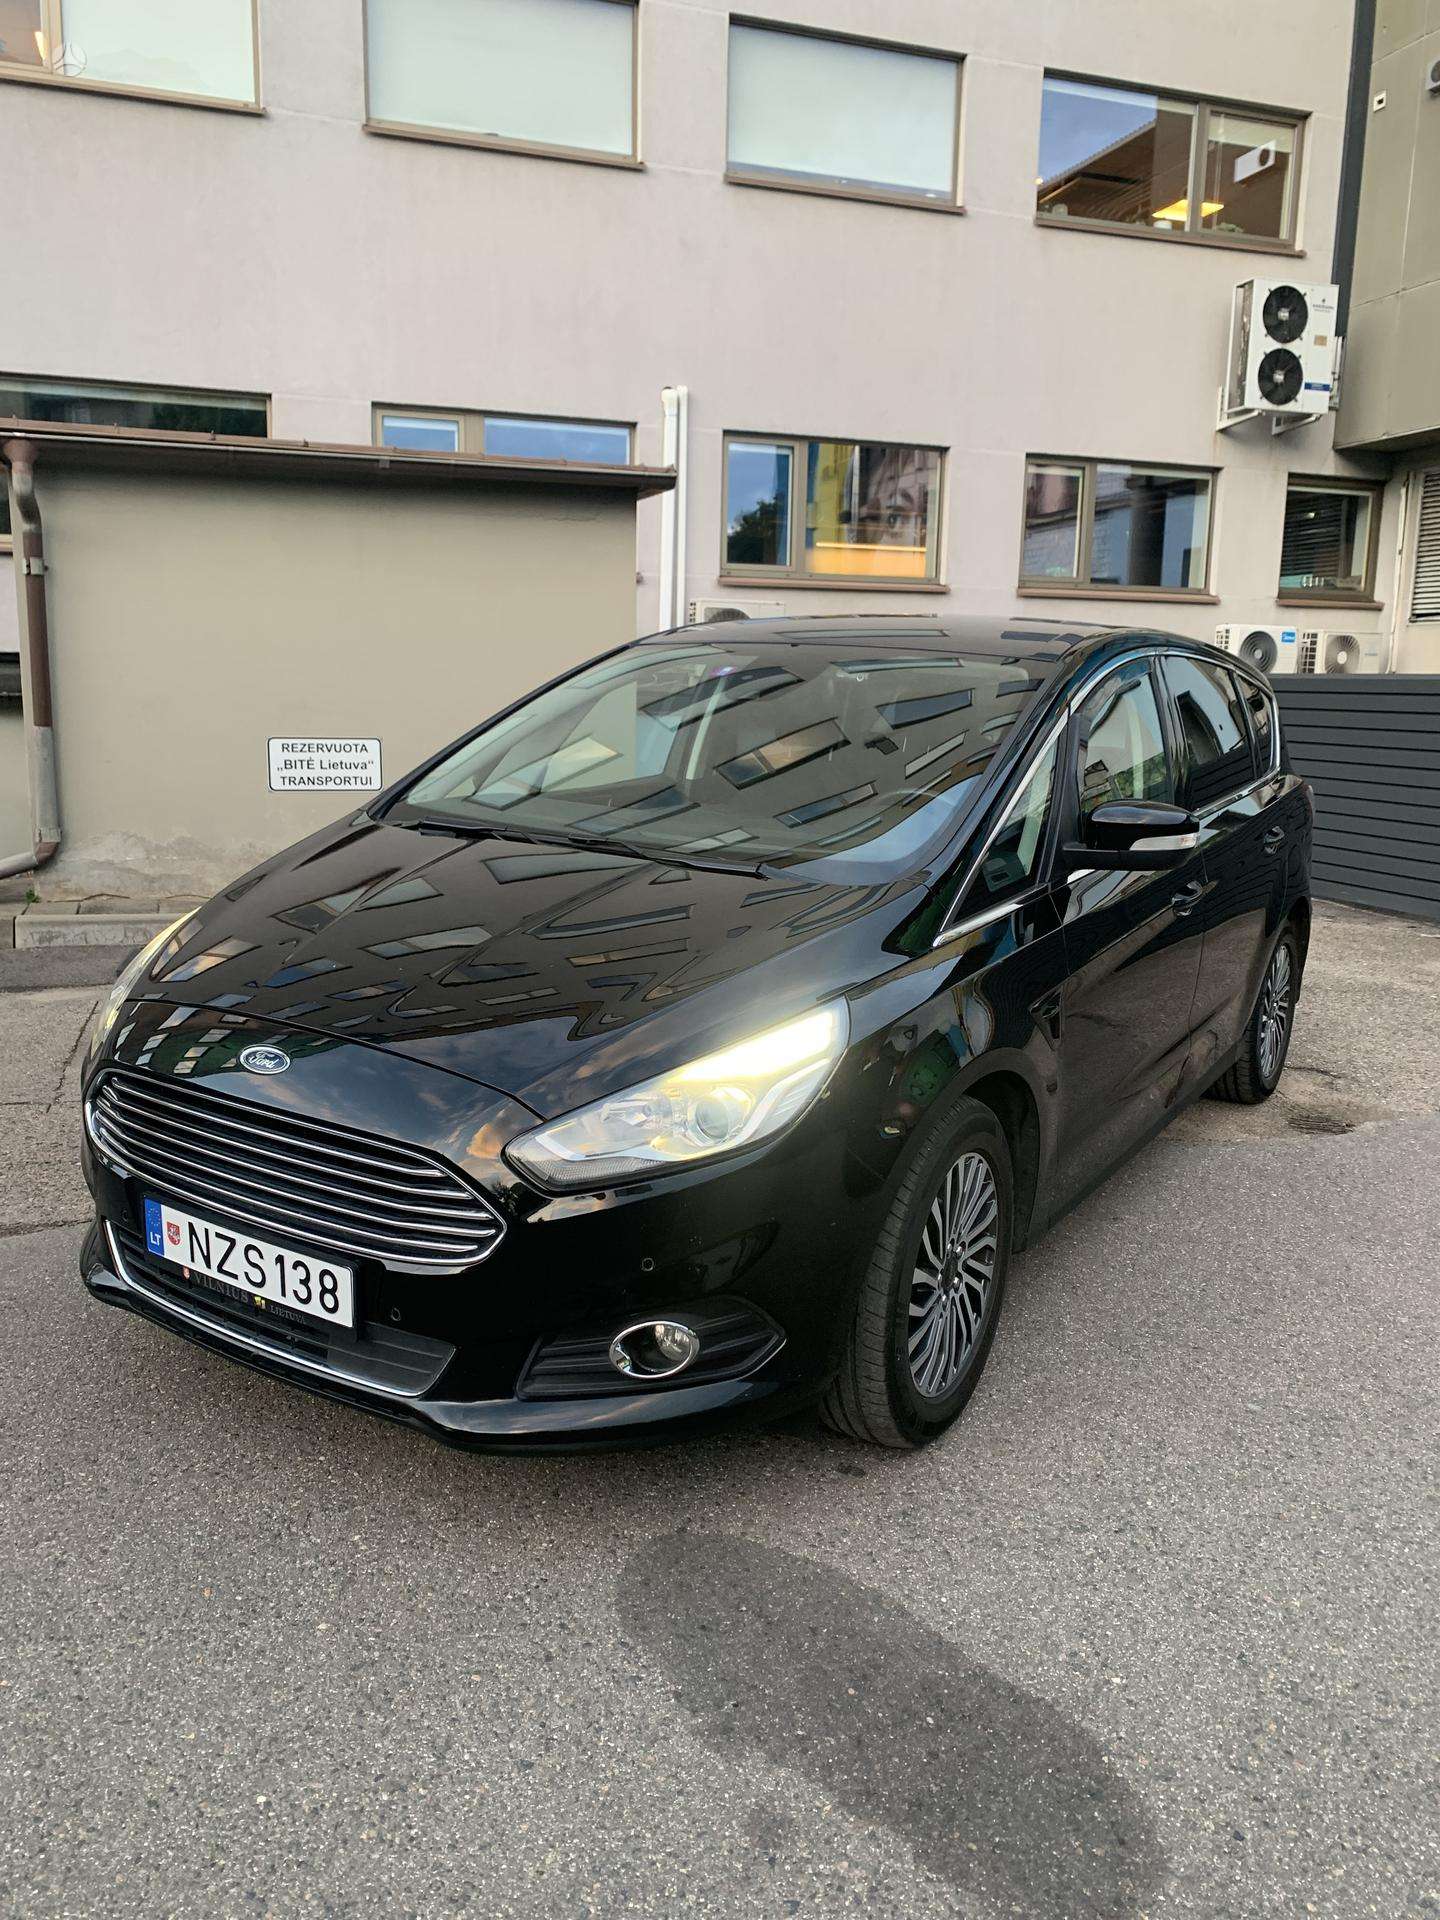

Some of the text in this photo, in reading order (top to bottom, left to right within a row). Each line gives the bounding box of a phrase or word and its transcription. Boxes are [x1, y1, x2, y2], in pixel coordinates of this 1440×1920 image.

[281, 743, 368, 753] REZERVUOTA
[280, 776, 372, 786] TRANSPORTUI
[249, 1051, 280, 1068] Ford
[150, 1232, 161, 1246] LT
[193, 1272, 248, 1303] VILNIUS
